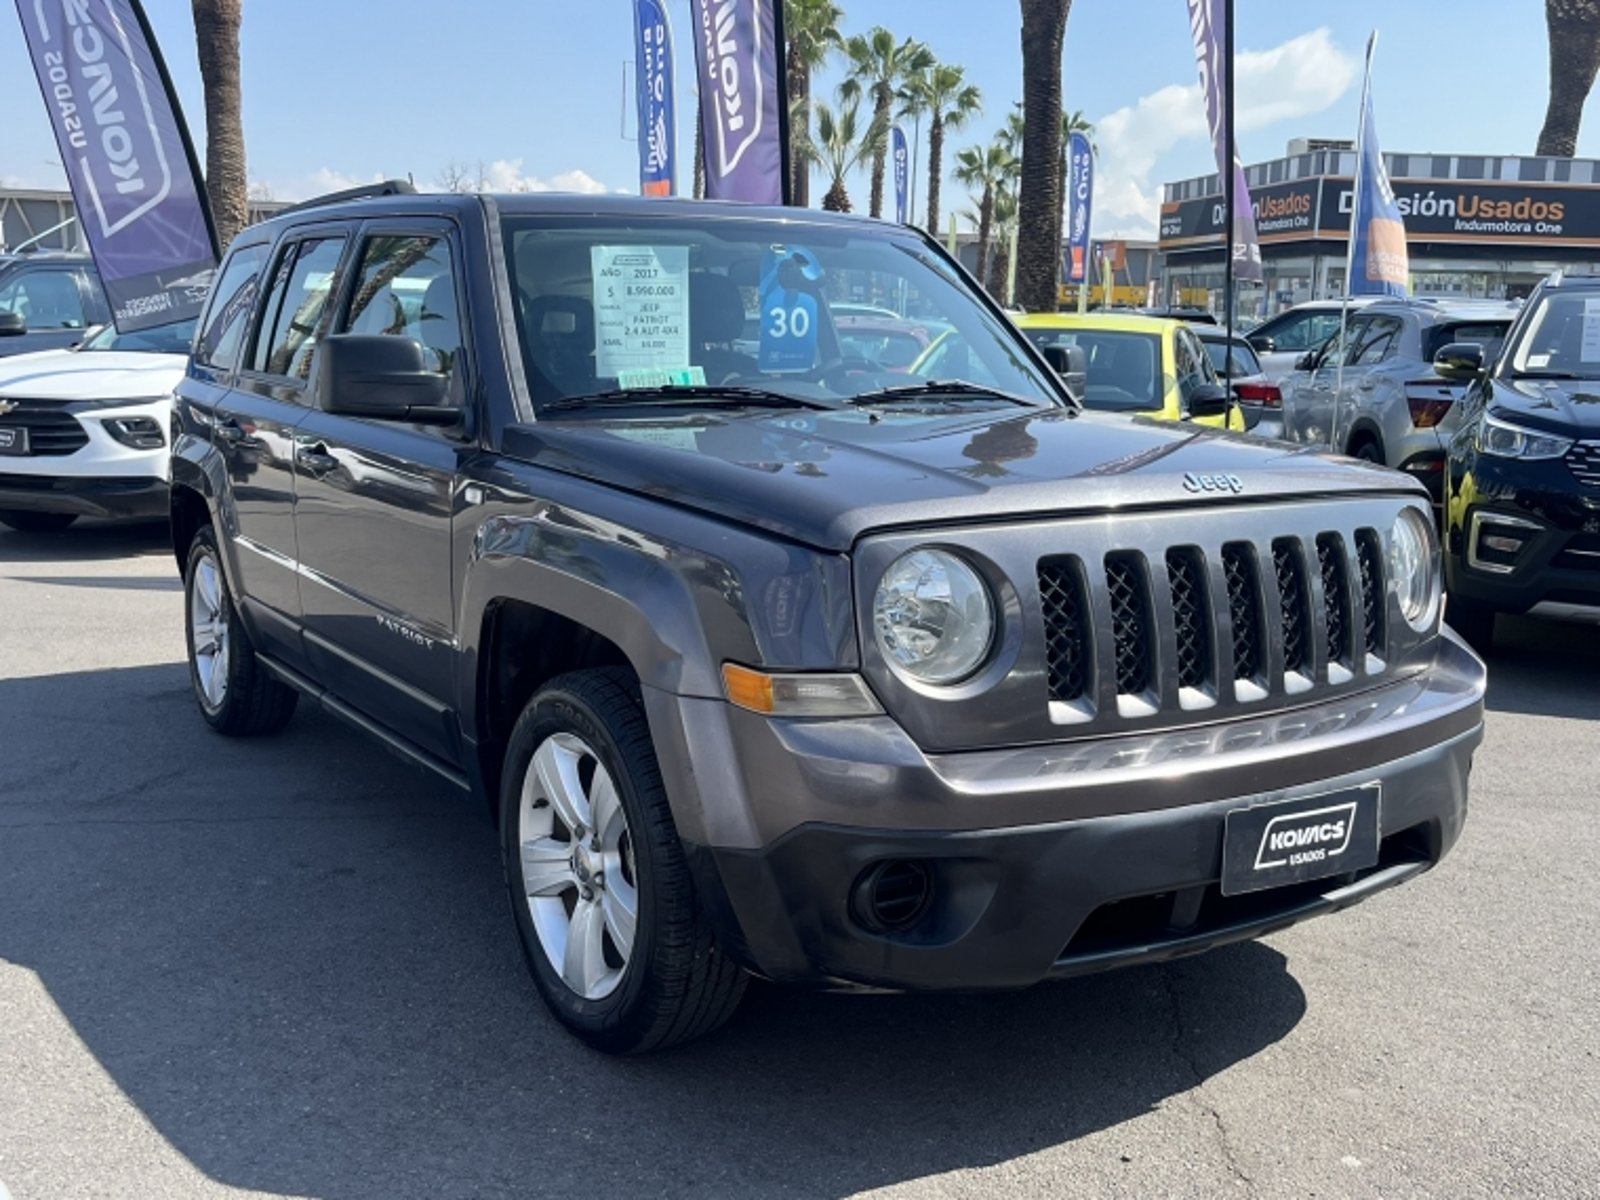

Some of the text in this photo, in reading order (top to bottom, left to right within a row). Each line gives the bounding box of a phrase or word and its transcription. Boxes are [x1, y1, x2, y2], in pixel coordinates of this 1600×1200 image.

[1454, 219, 1562, 234] Indumotora One
[633, 269, 658, 278] 2017
[769, 307, 809, 338] 30
[1182, 471, 1243, 493] Jeep
[1270, 820, 1344, 851] KOVACS
[1289, 848, 1326, 866] USADOS
